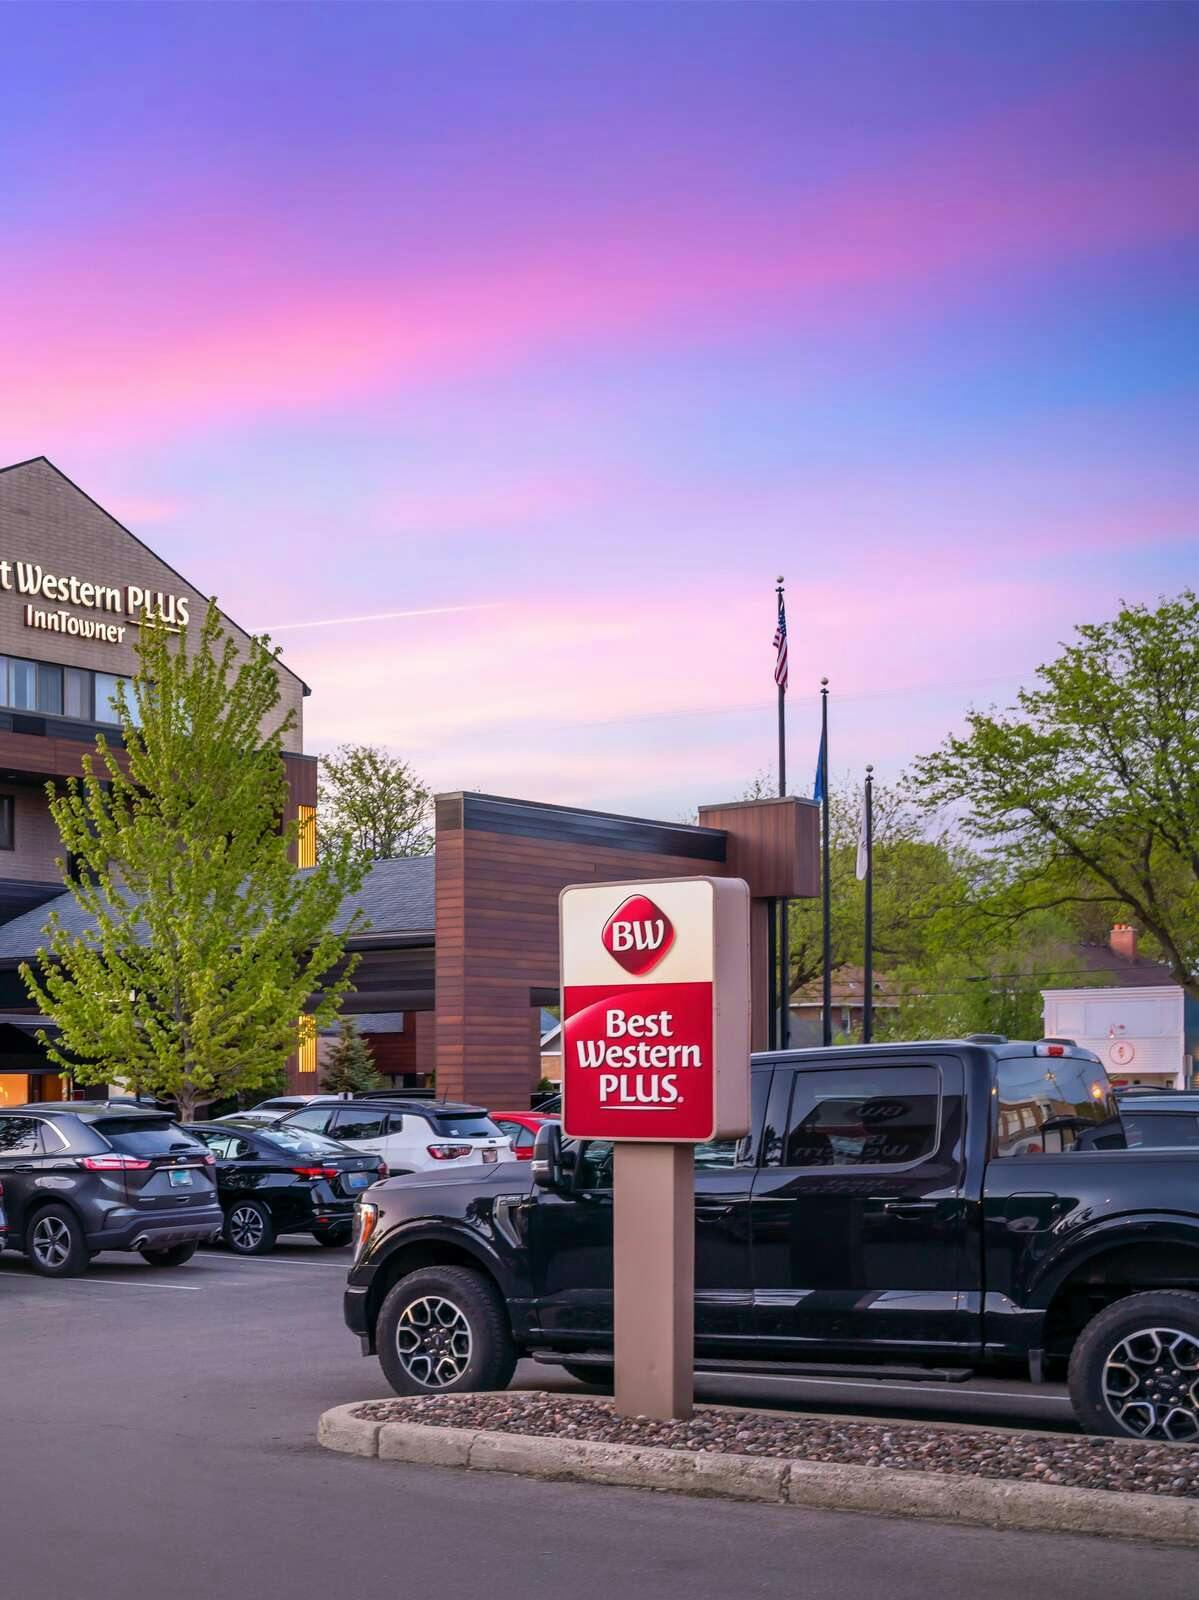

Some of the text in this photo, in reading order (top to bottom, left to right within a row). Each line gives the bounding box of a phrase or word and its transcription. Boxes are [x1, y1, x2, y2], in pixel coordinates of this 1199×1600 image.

[16, 561, 121, 612] Western
[127, 585, 189, 626] PLUS
[26, 604, 126, 643] InnTowner
[611, 919, 665, 951] BW
[606, 1009, 673, 1037] Best
[576, 1040, 702, 1067] Western
